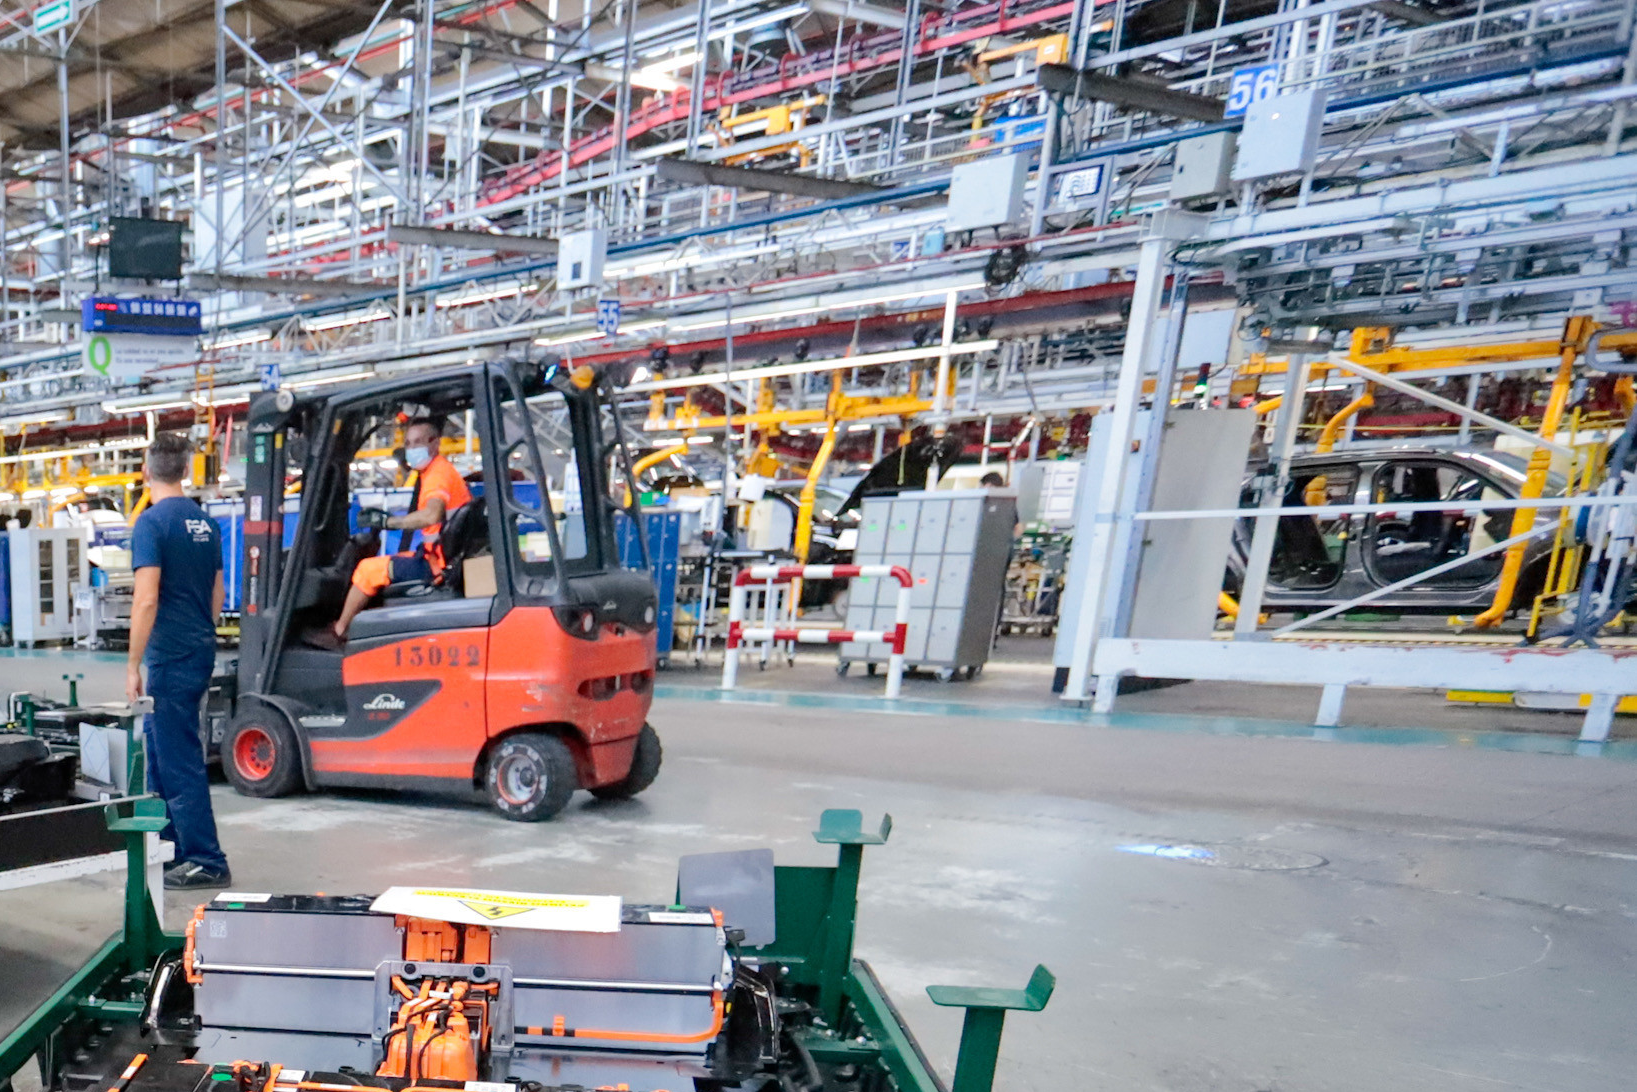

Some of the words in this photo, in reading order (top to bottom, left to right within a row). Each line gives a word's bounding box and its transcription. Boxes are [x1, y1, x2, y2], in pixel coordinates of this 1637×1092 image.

[1228, 68, 1277, 110] 56
[597, 302, 618, 333] 55
[88, 336, 111, 376] Q
[261, 366, 279, 390] 54
[185, 519, 212, 534] PSA
[395, 645, 480, 667] 13022
[363, 693, 405, 710] Linde
